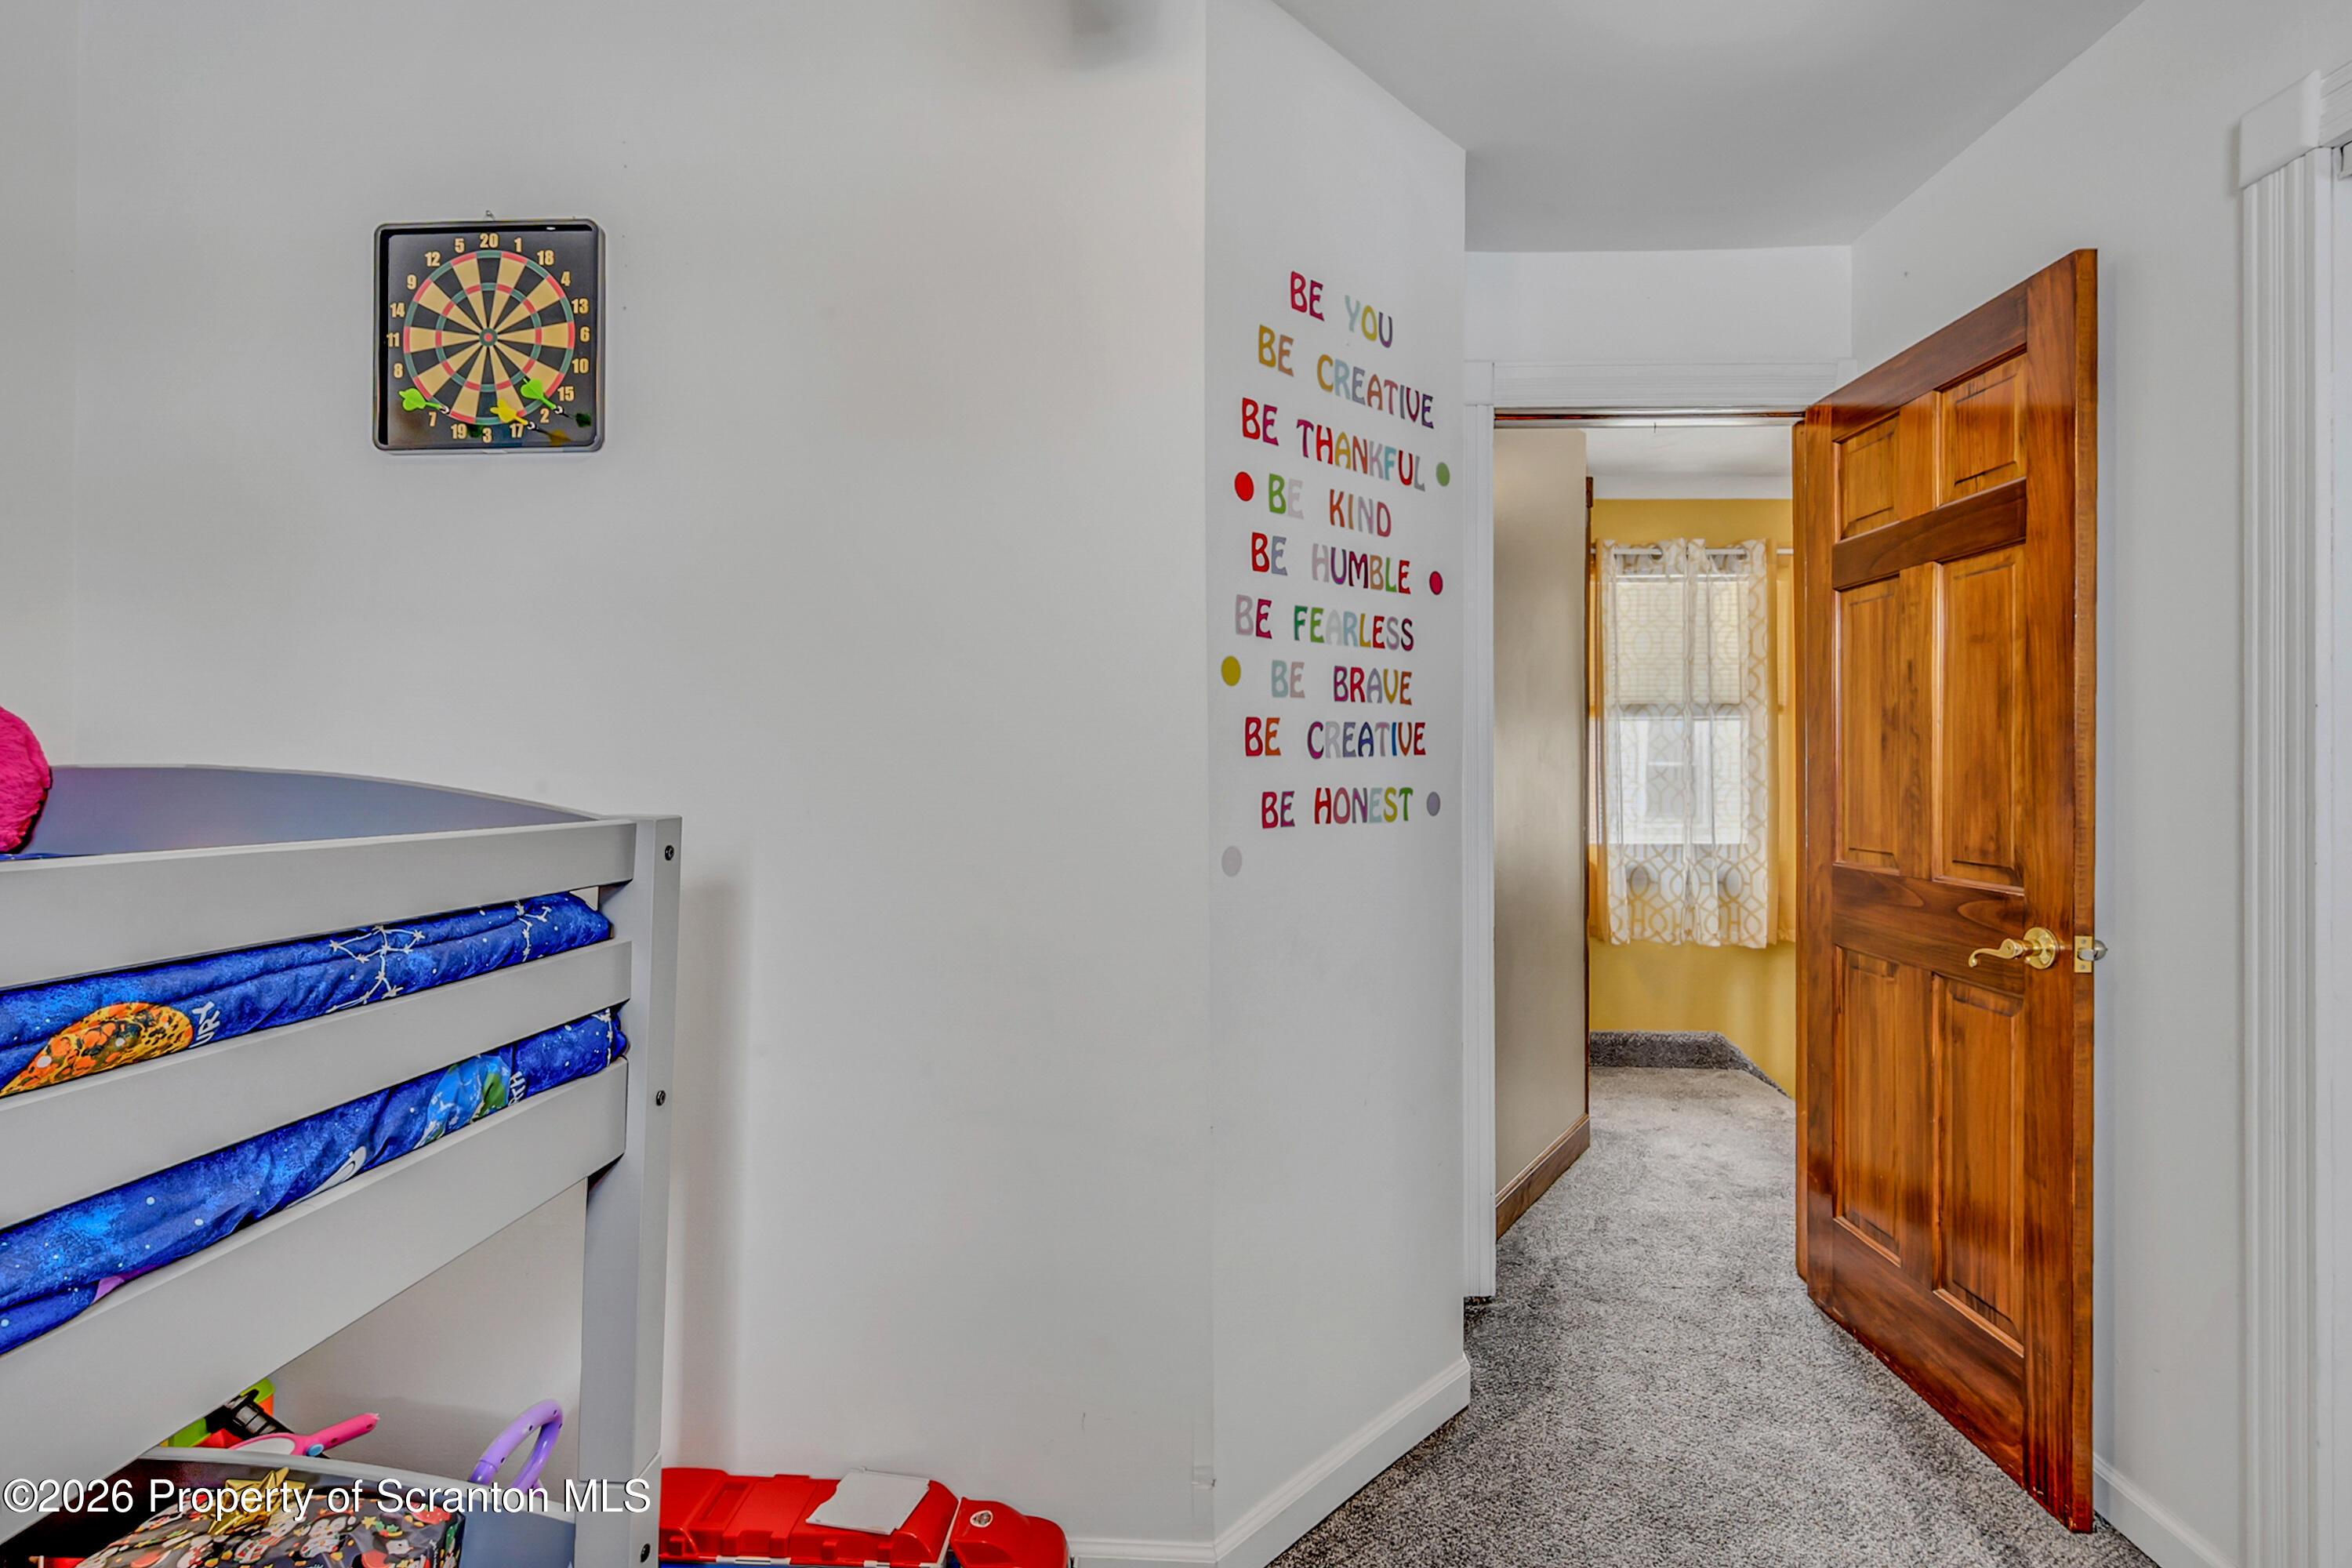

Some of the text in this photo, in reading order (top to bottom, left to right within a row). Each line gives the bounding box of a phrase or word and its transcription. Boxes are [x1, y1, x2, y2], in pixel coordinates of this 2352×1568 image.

[455, 238, 465, 253] 5
[480, 233, 499, 249] 20
[514, 238, 522, 252] 1
[425, 252, 441, 267] 12
[537, 251, 554, 266] 18
[407, 274, 417, 289] 9
[561, 271, 571, 286] 4
[390, 303, 405, 318] 14
[572, 298, 589, 314] 13
[1290, 270, 1392, 348] BE YOU
[387, 332, 400, 347] 11
[580, 327, 590, 342] 6
[394, 363, 403, 379] 8
[572, 358, 590, 374] 10
[1258, 325, 1434, 429] BE CREATIVE
[557, 387, 575, 401] 15
[429, 412, 437, 426] 7
[540, 408, 550, 423] 2
[451, 424, 467, 439] 19
[482, 428, 492, 443] 3
[510, 423, 524, 438] 17
[1242, 397, 1425, 492] BE THANKFUL
[1269, 473, 1391, 537] BE KIND
[1251, 532, 1410, 594] BE HUMBLE
[1236, 594, 1414, 651] BE FEARLESS
[1271, 660, 1412, 705] BE BRAVE
[1244, 717, 1425, 760] BE CREATIVE
[1261, 787, 1413, 829] BE HONEST
